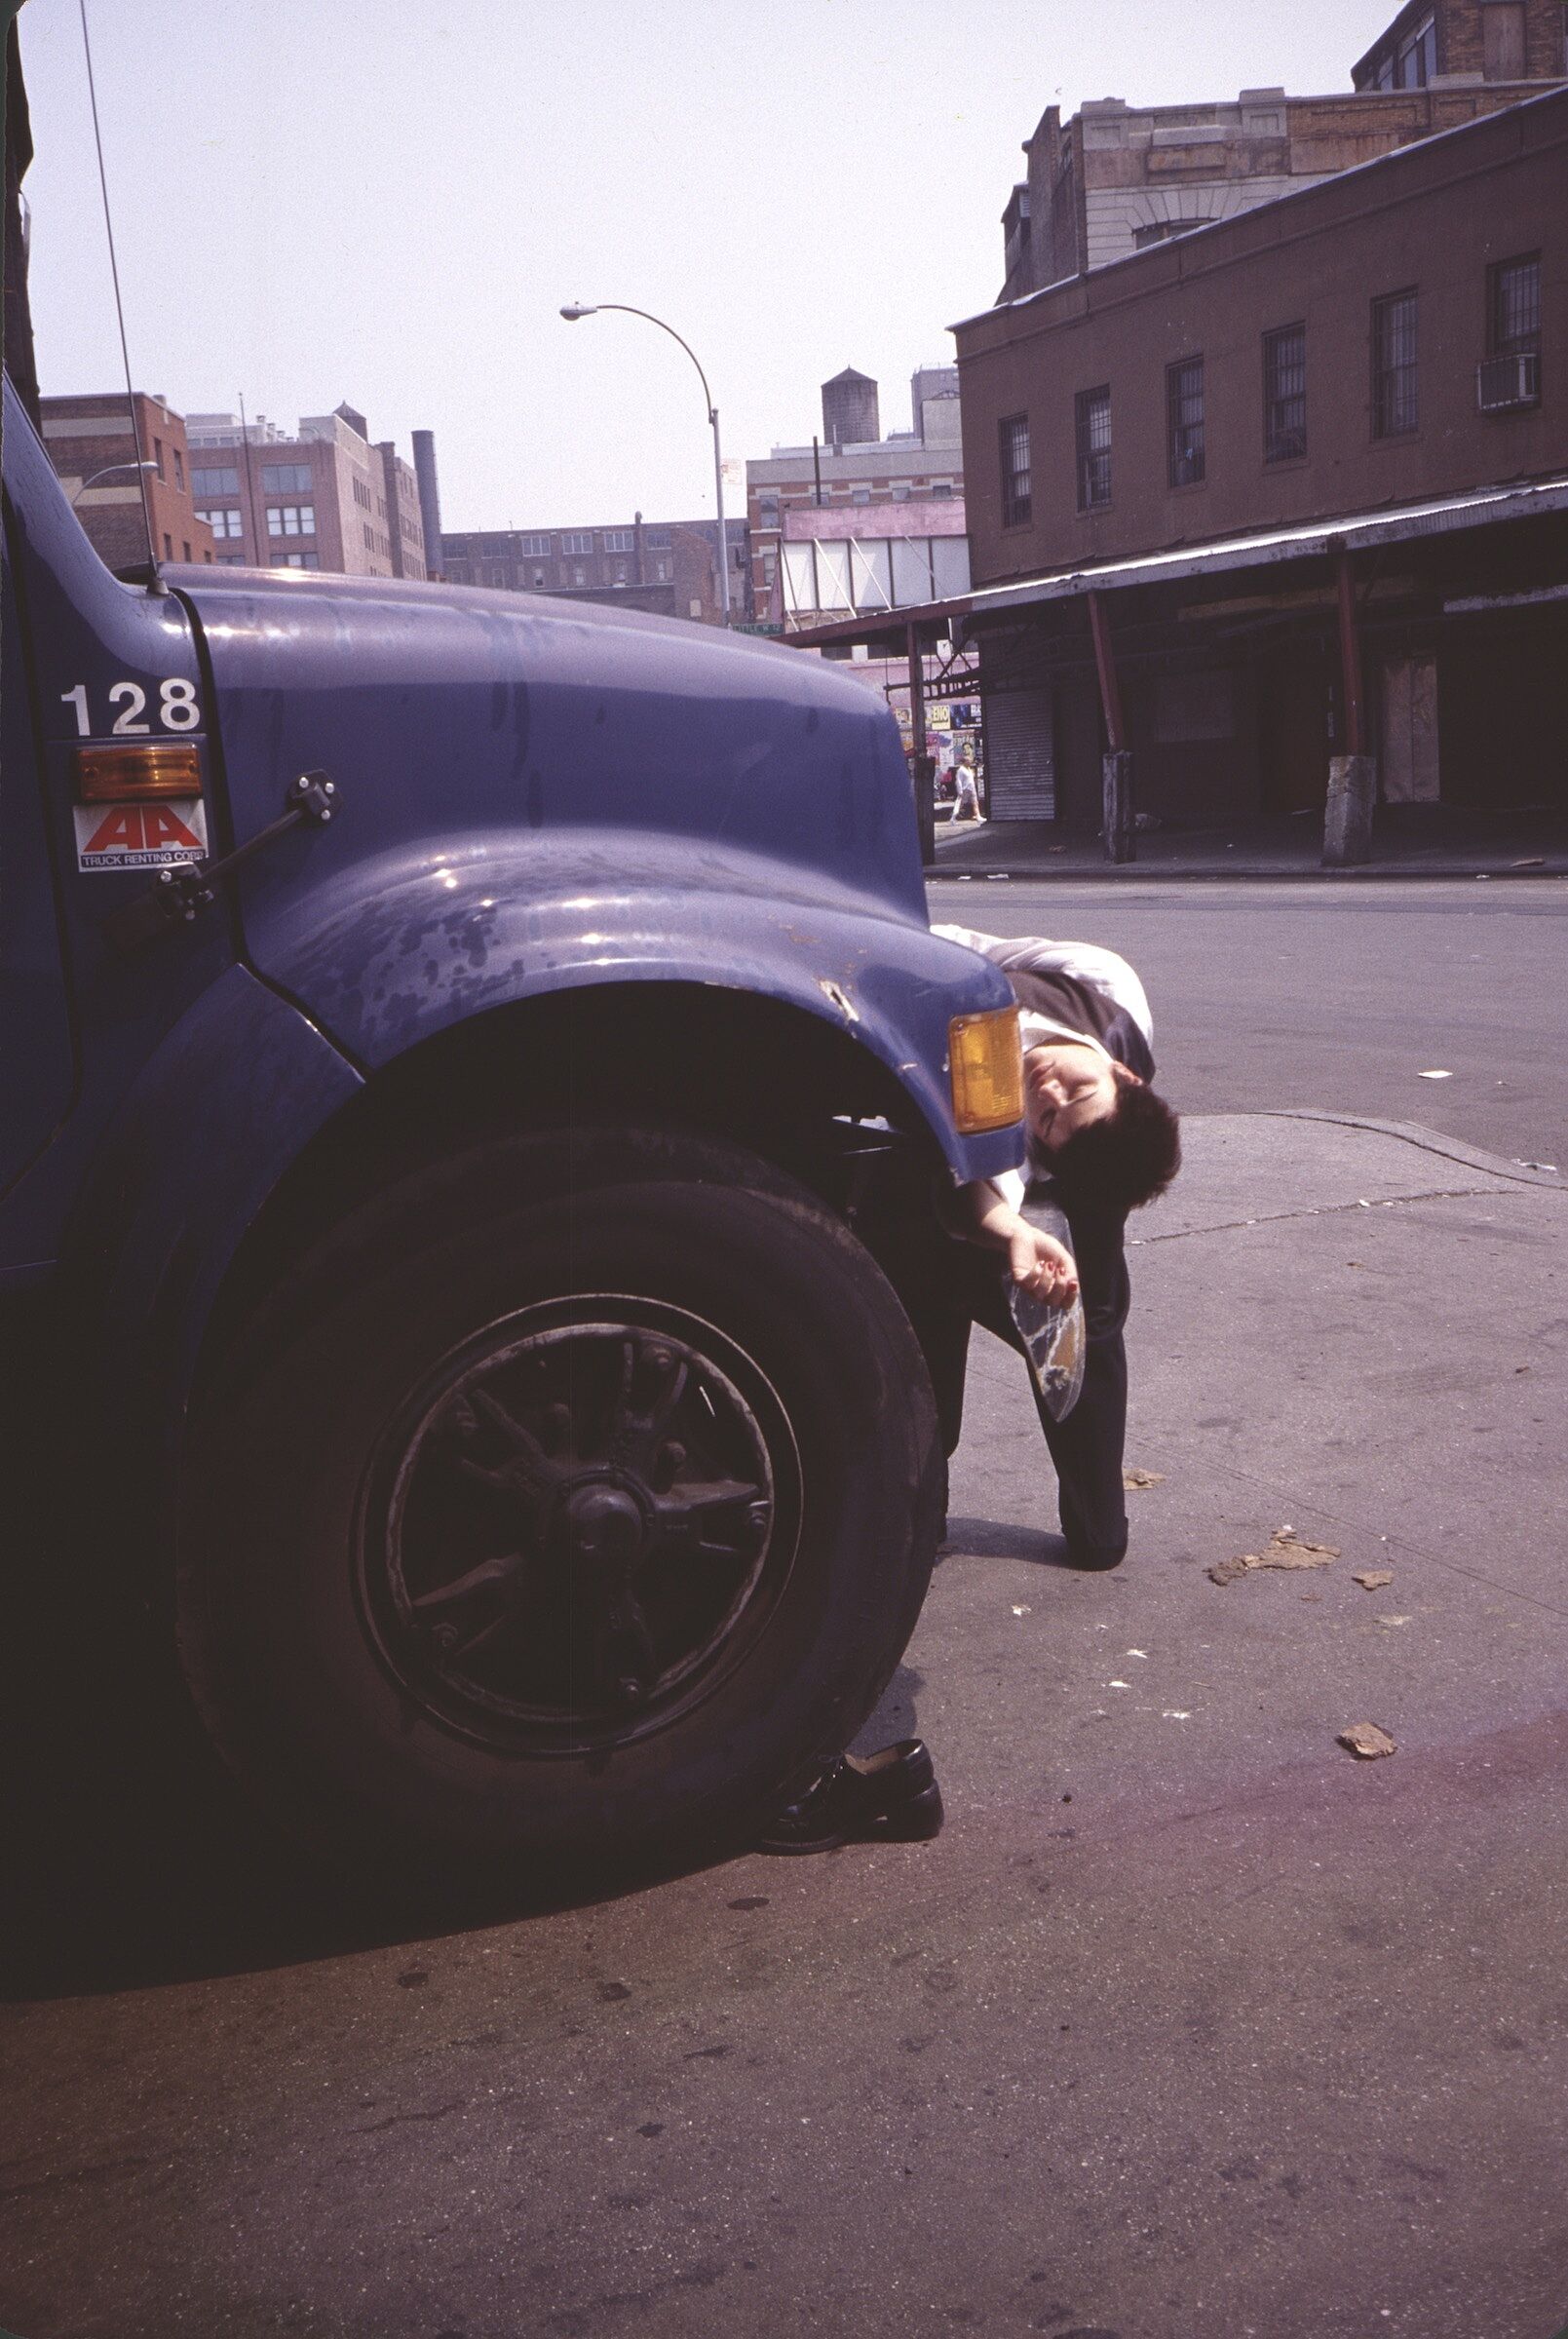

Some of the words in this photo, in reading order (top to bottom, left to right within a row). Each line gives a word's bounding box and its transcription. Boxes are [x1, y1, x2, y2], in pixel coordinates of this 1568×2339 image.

[60, 677, 201, 737] 128
[82, 856, 123, 866] TRUCK
[124, 852, 172, 864] RENTING
